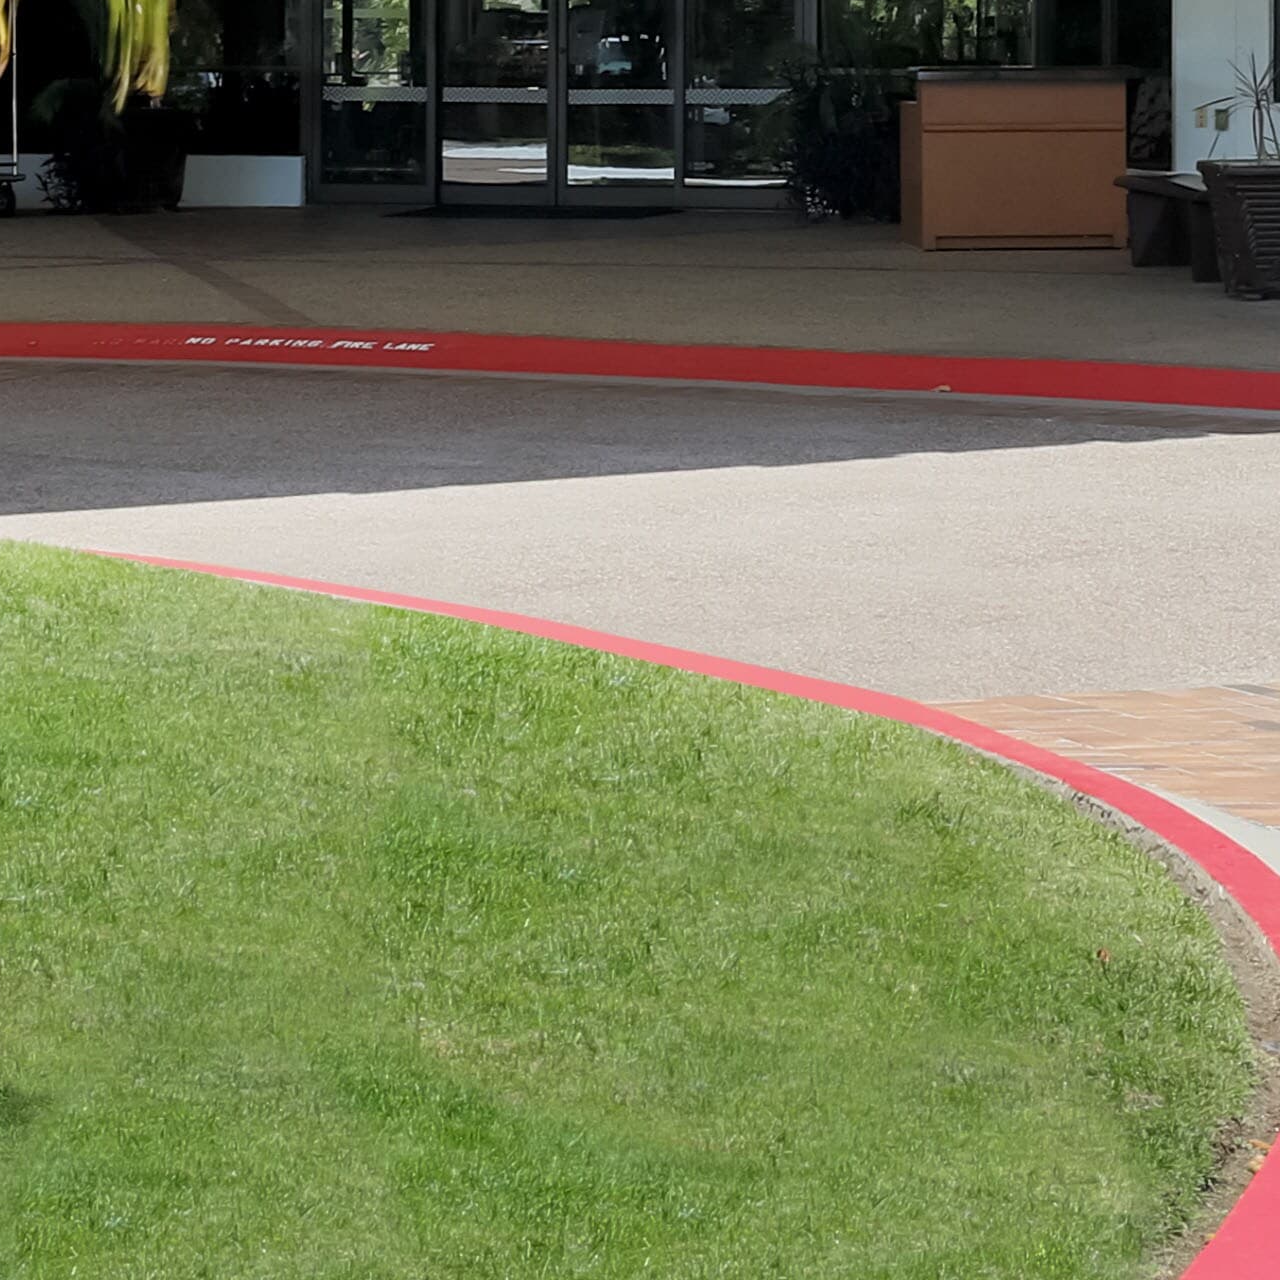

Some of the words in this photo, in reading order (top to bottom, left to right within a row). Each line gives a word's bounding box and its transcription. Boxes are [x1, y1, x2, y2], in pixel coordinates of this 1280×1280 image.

[184, 336, 217, 346] NO
[224, 337, 324, 349] PARKING
[329, 339, 379, 350] FIRE
[383, 342, 436, 352] LANE
